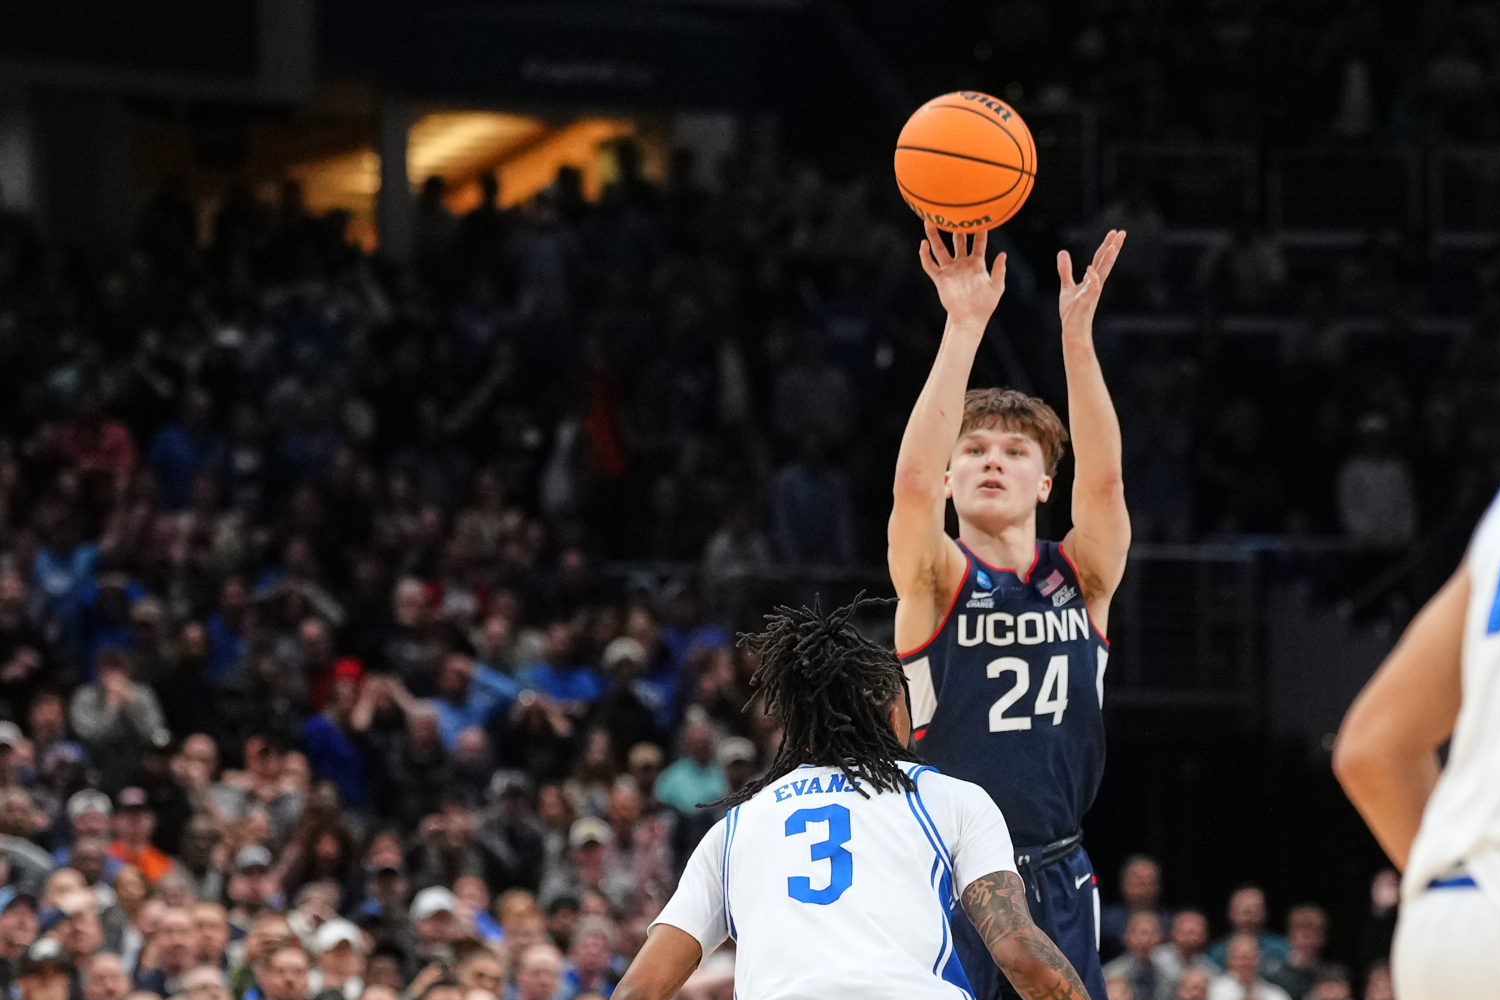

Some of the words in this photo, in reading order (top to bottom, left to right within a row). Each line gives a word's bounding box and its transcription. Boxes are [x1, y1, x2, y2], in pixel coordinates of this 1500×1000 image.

[958, 607, 1089, 647] UCONN
[966, 600, 995, 609] CHANGE
[987, 655, 1068, 732] 24
[785, 803, 853, 905] 3
